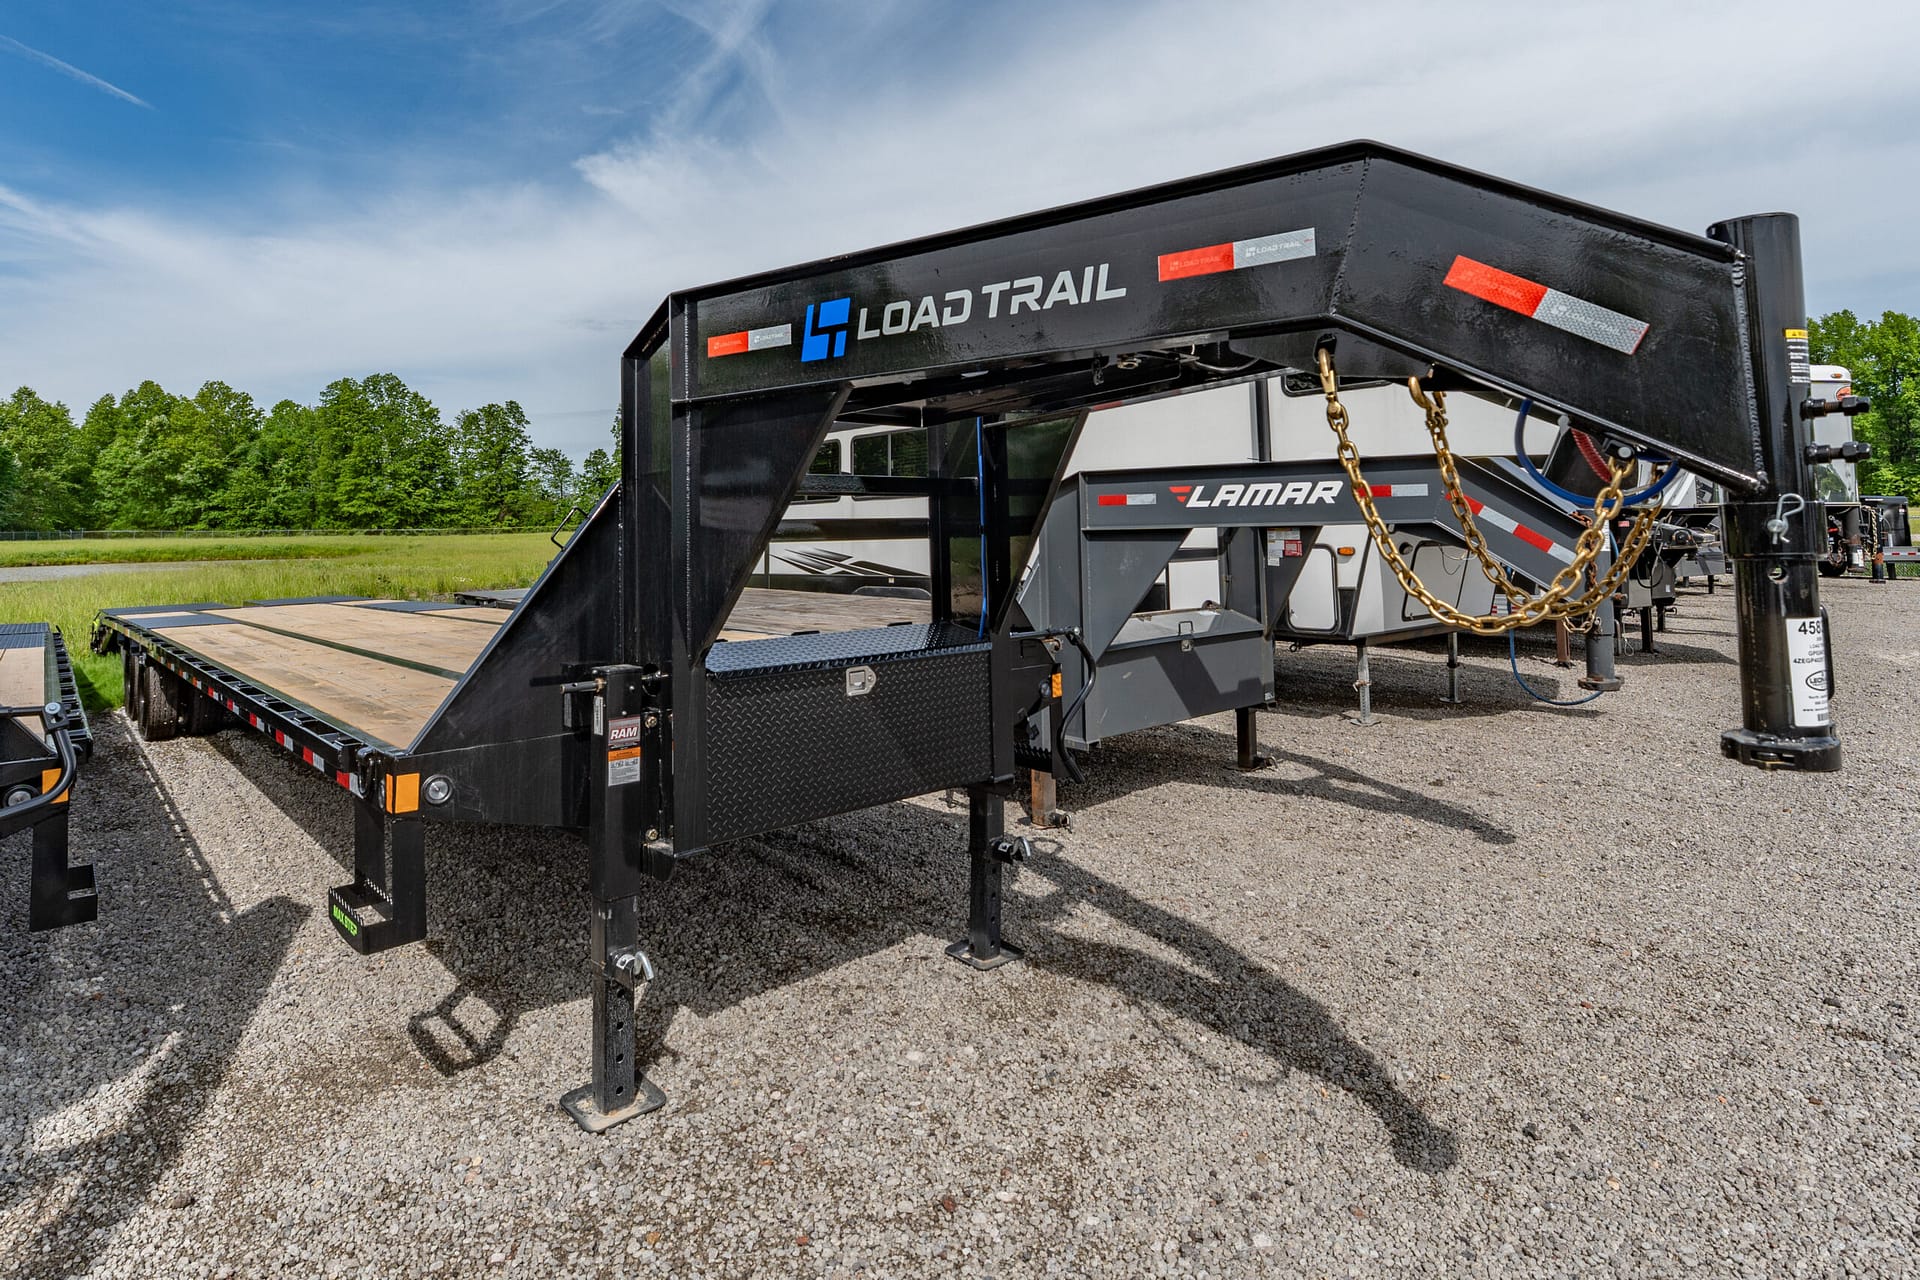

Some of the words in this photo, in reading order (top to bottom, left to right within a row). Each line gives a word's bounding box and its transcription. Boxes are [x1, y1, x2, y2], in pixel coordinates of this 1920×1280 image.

[857, 289, 972, 340] LOAD
[981, 263, 1127, 319] TRAIL
[1185, 480, 1344, 509] LAMAR
[610, 726, 638, 739] RAM
